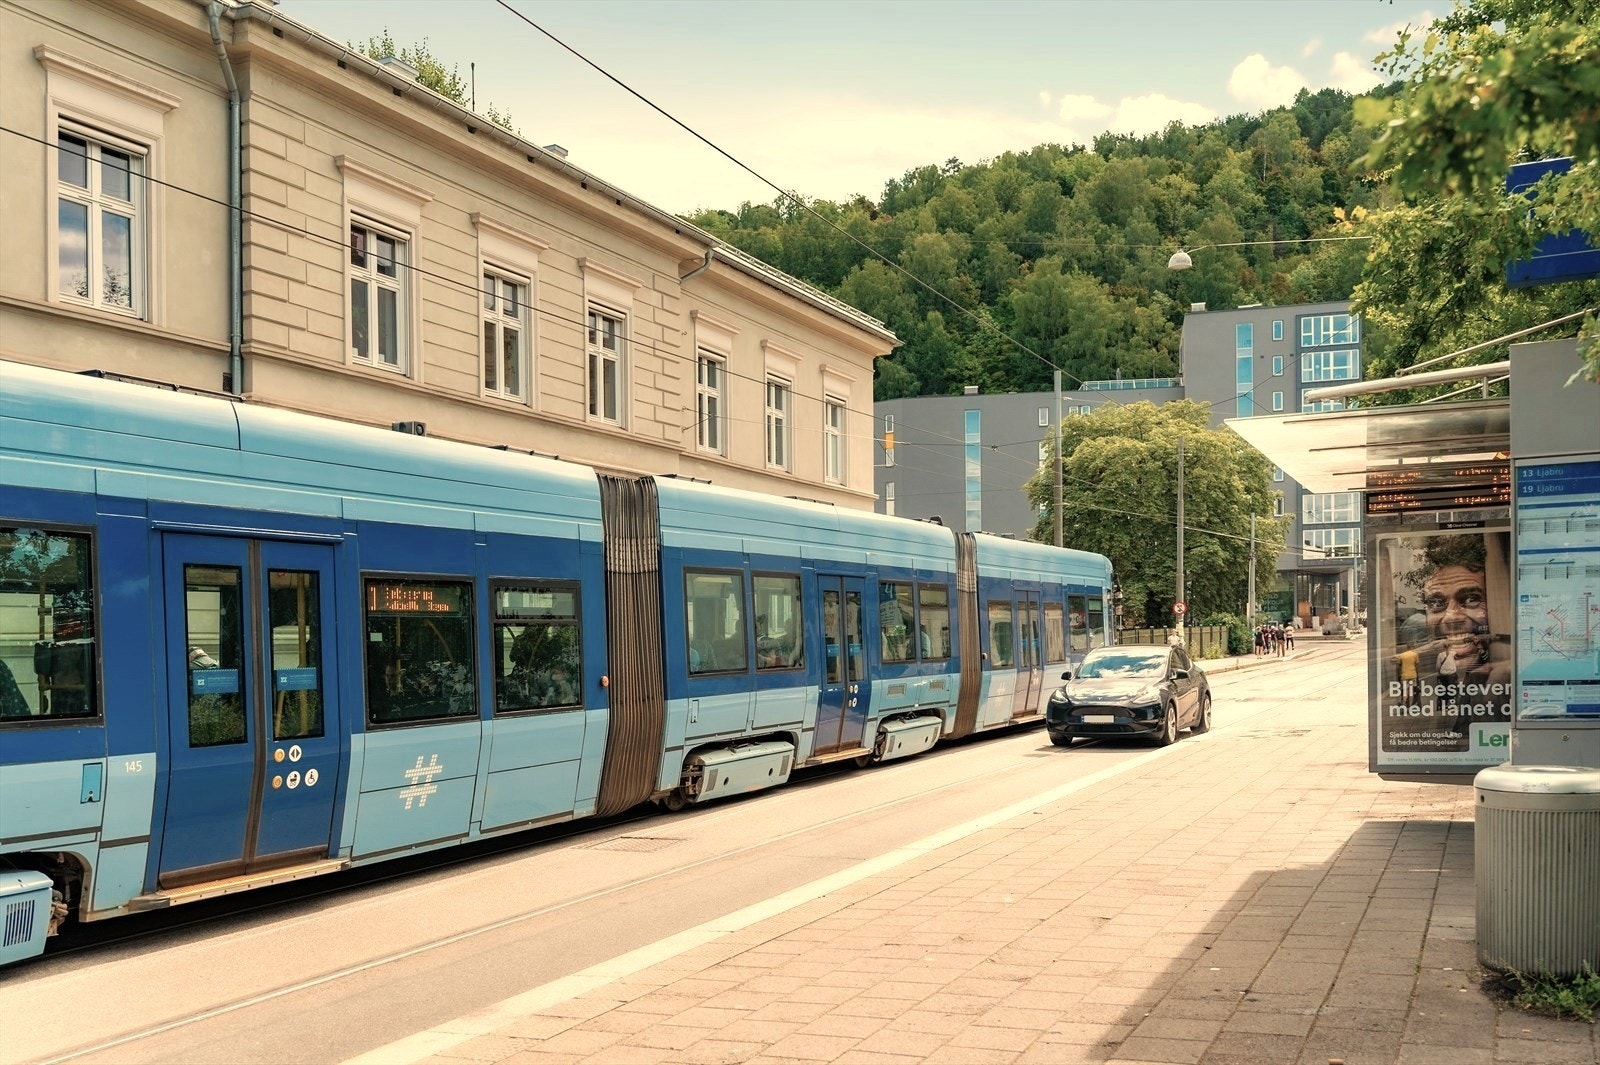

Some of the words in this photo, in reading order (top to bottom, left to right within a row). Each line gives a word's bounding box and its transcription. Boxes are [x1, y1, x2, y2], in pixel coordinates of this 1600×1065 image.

[1522, 469, 1534, 478] 13
[1536, 468, 1564, 478] Ljabru
[1522, 485, 1534, 494] 19
[1536, 484, 1564, 494] Ljabru
[1389, 680, 1414, 697] Bli
[1389, 700, 1434, 717] med
[1441, 698, 1494, 717] lånet
[1389, 731, 1409, 740] Sjekk
[1397, 738, 1418, 746] bedre
[1419, 738, 1457, 747] betingelser
[124, 760, 143, 773] 145
